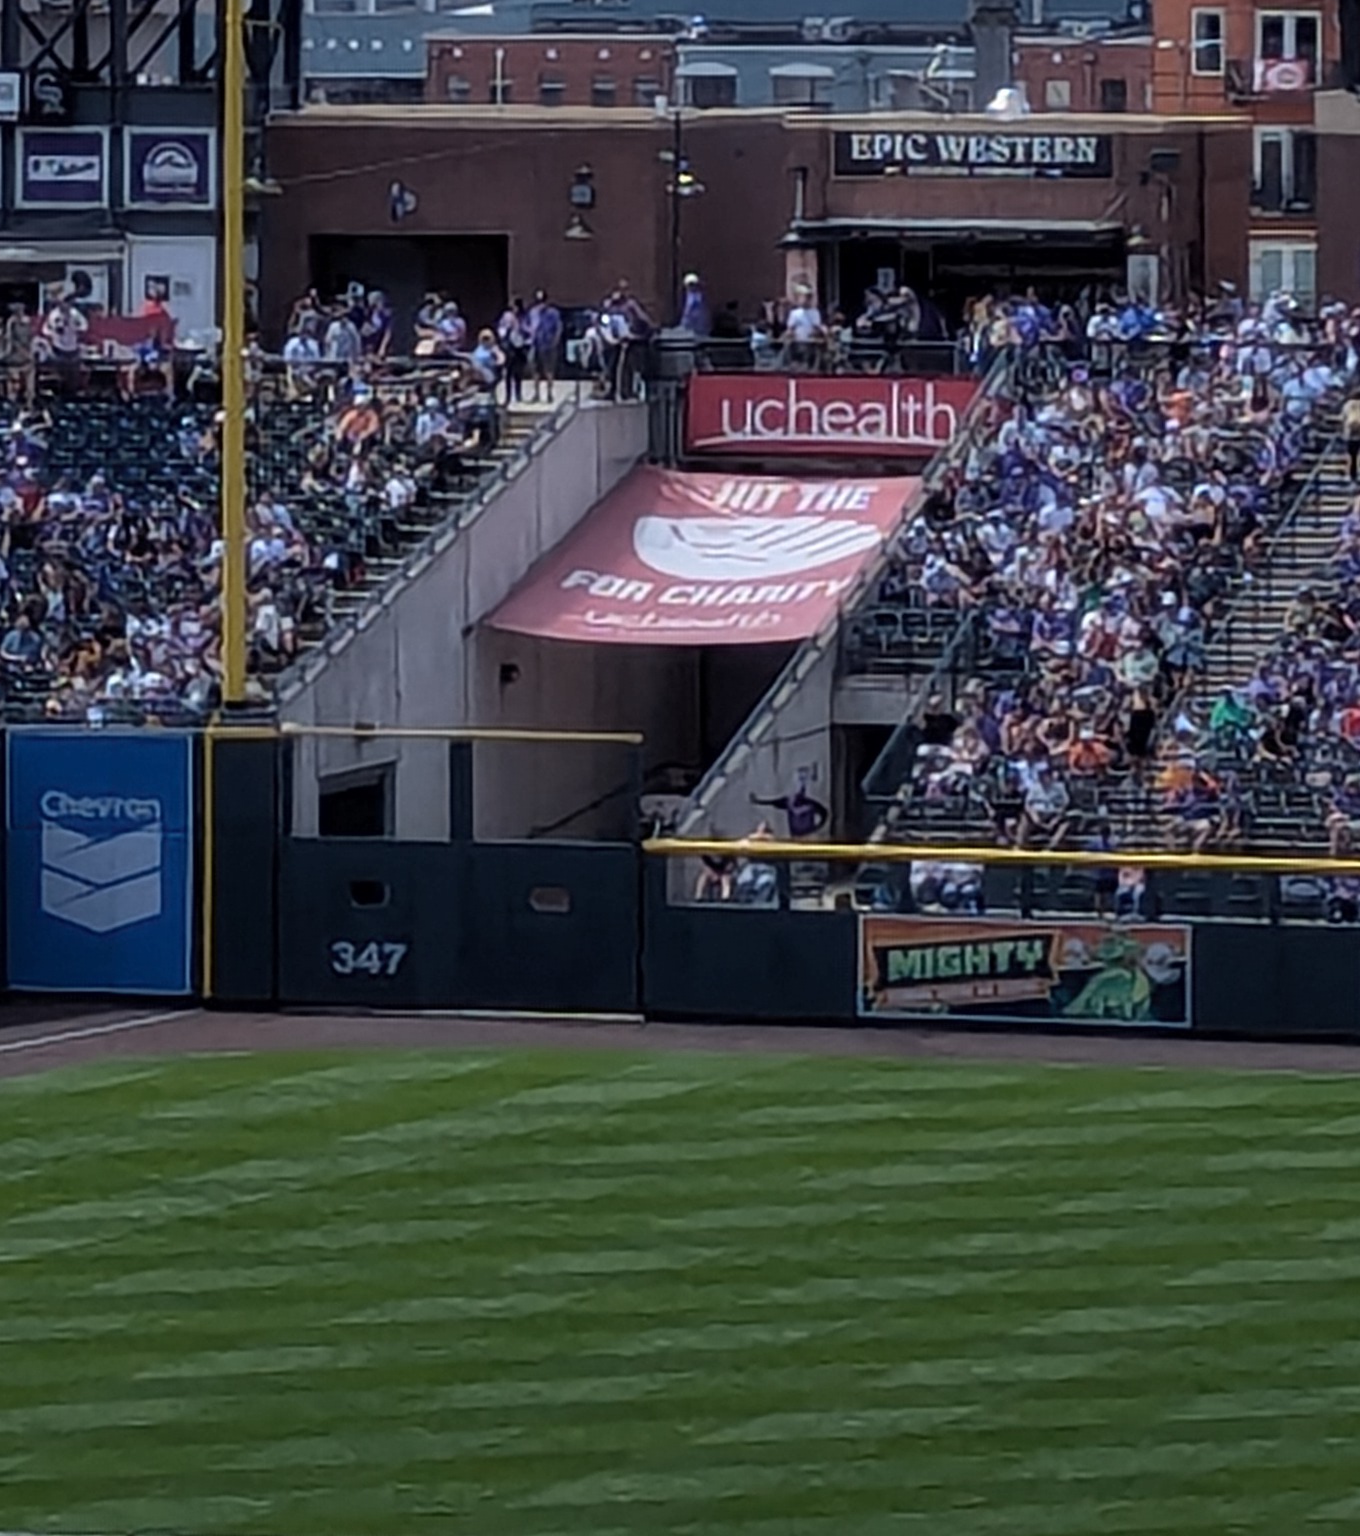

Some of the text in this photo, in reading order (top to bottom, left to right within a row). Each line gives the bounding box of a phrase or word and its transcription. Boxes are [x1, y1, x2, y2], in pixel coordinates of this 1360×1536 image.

[851, 134, 1098, 163] EPIC WESTERN
[721, 379, 957, 441] uchealth
[795, 485, 879, 512] THE
[561, 570, 853, 607] FOR CHARITY
[40, 790, 160, 821] Chevron
[332, 941, 406, 975] 347
[888, 939, 1045, 982] MIGHTY
